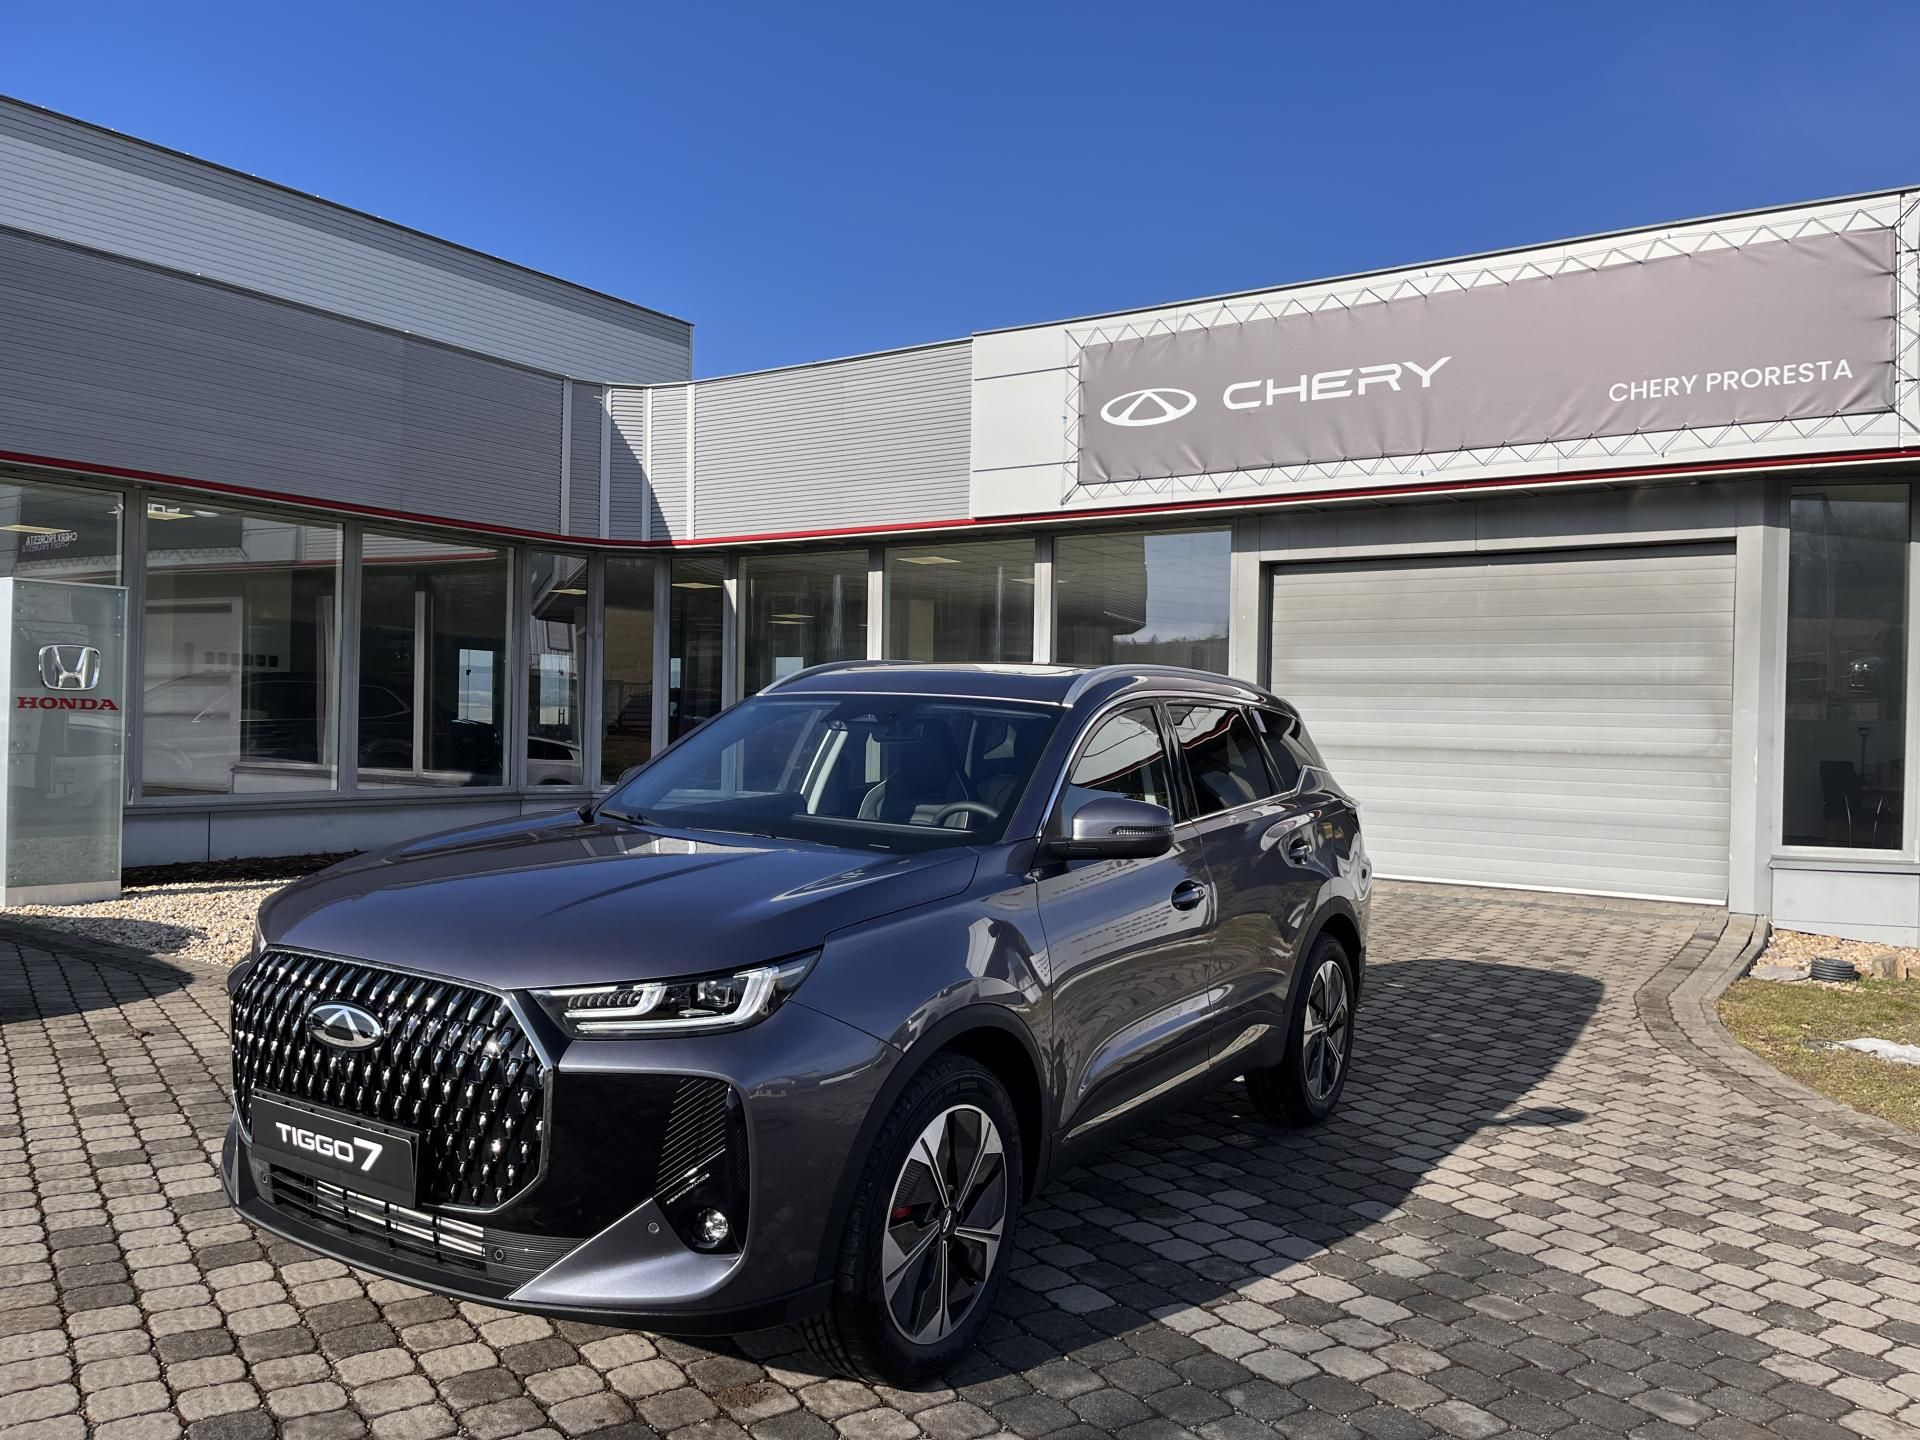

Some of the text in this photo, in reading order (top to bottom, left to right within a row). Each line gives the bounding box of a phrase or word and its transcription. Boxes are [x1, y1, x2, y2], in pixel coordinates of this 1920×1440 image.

[1222, 356, 1452, 410] CHERY
[1608, 358, 1853, 402] CHERY PRORESTA
[16, 696, 119, 711] HONDA
